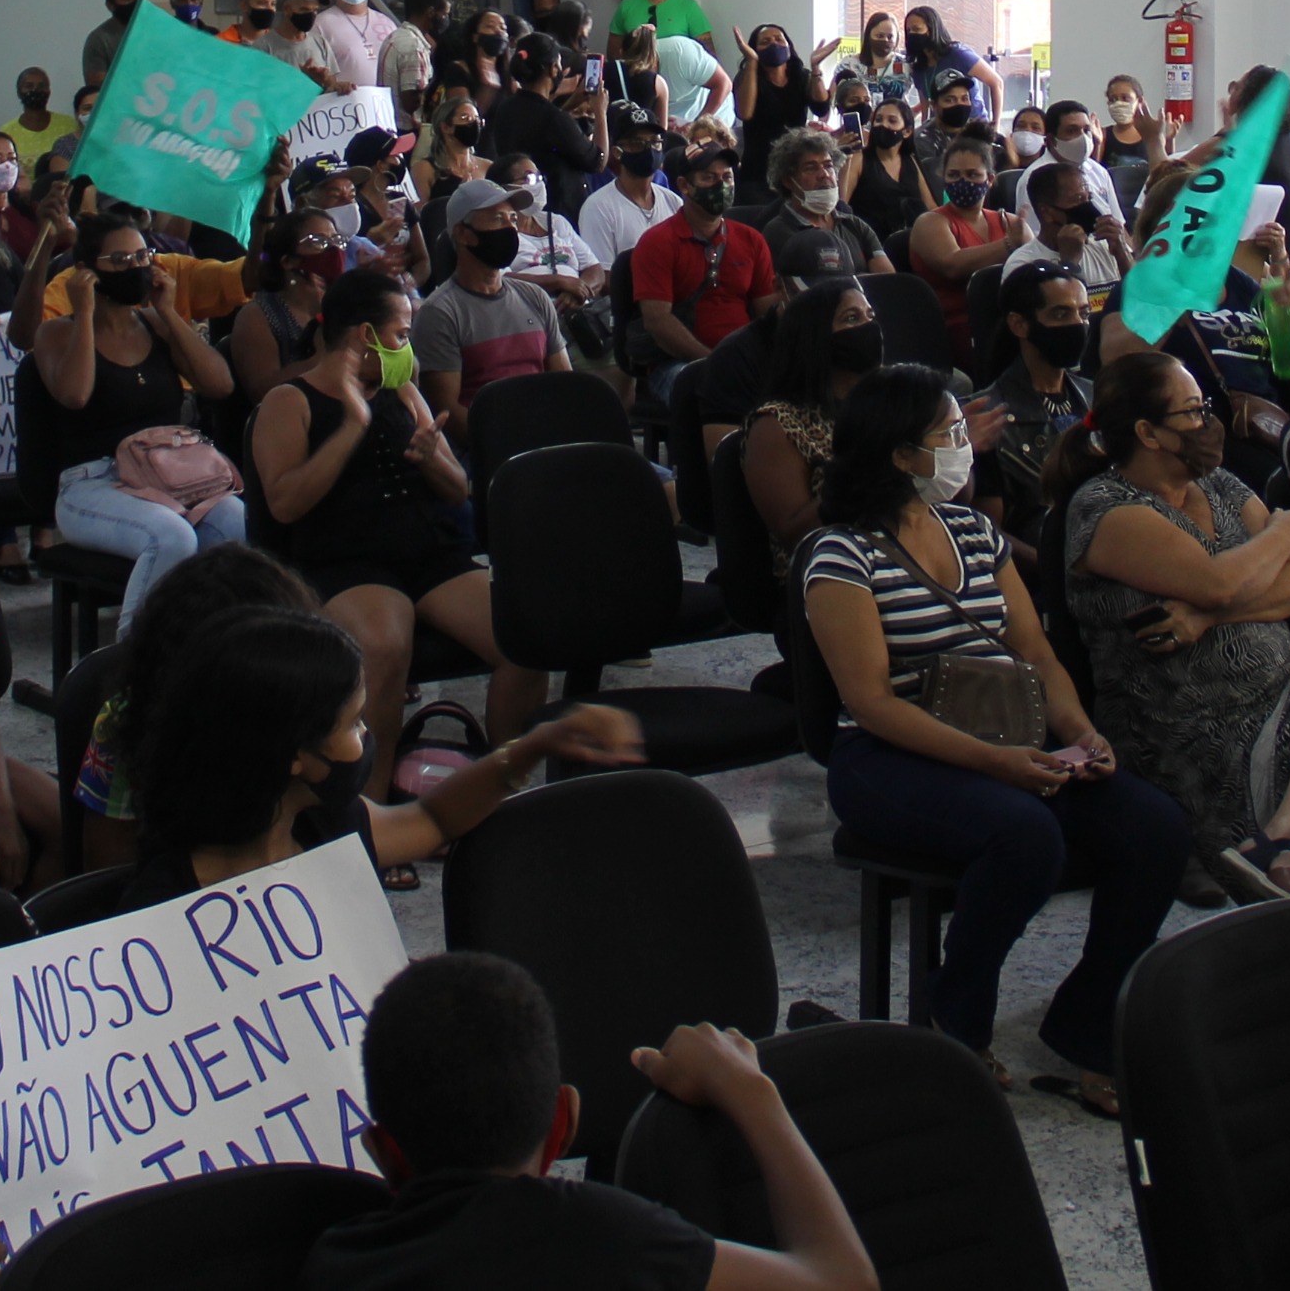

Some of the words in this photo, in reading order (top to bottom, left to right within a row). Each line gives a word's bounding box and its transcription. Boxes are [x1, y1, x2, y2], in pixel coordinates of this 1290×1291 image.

[133, 72, 262, 149] S.O.S
[297, 103, 368, 144] NOSSO
[12, 937, 173, 1062] NOSSO
[86, 973, 370, 1153] AGUENTA
